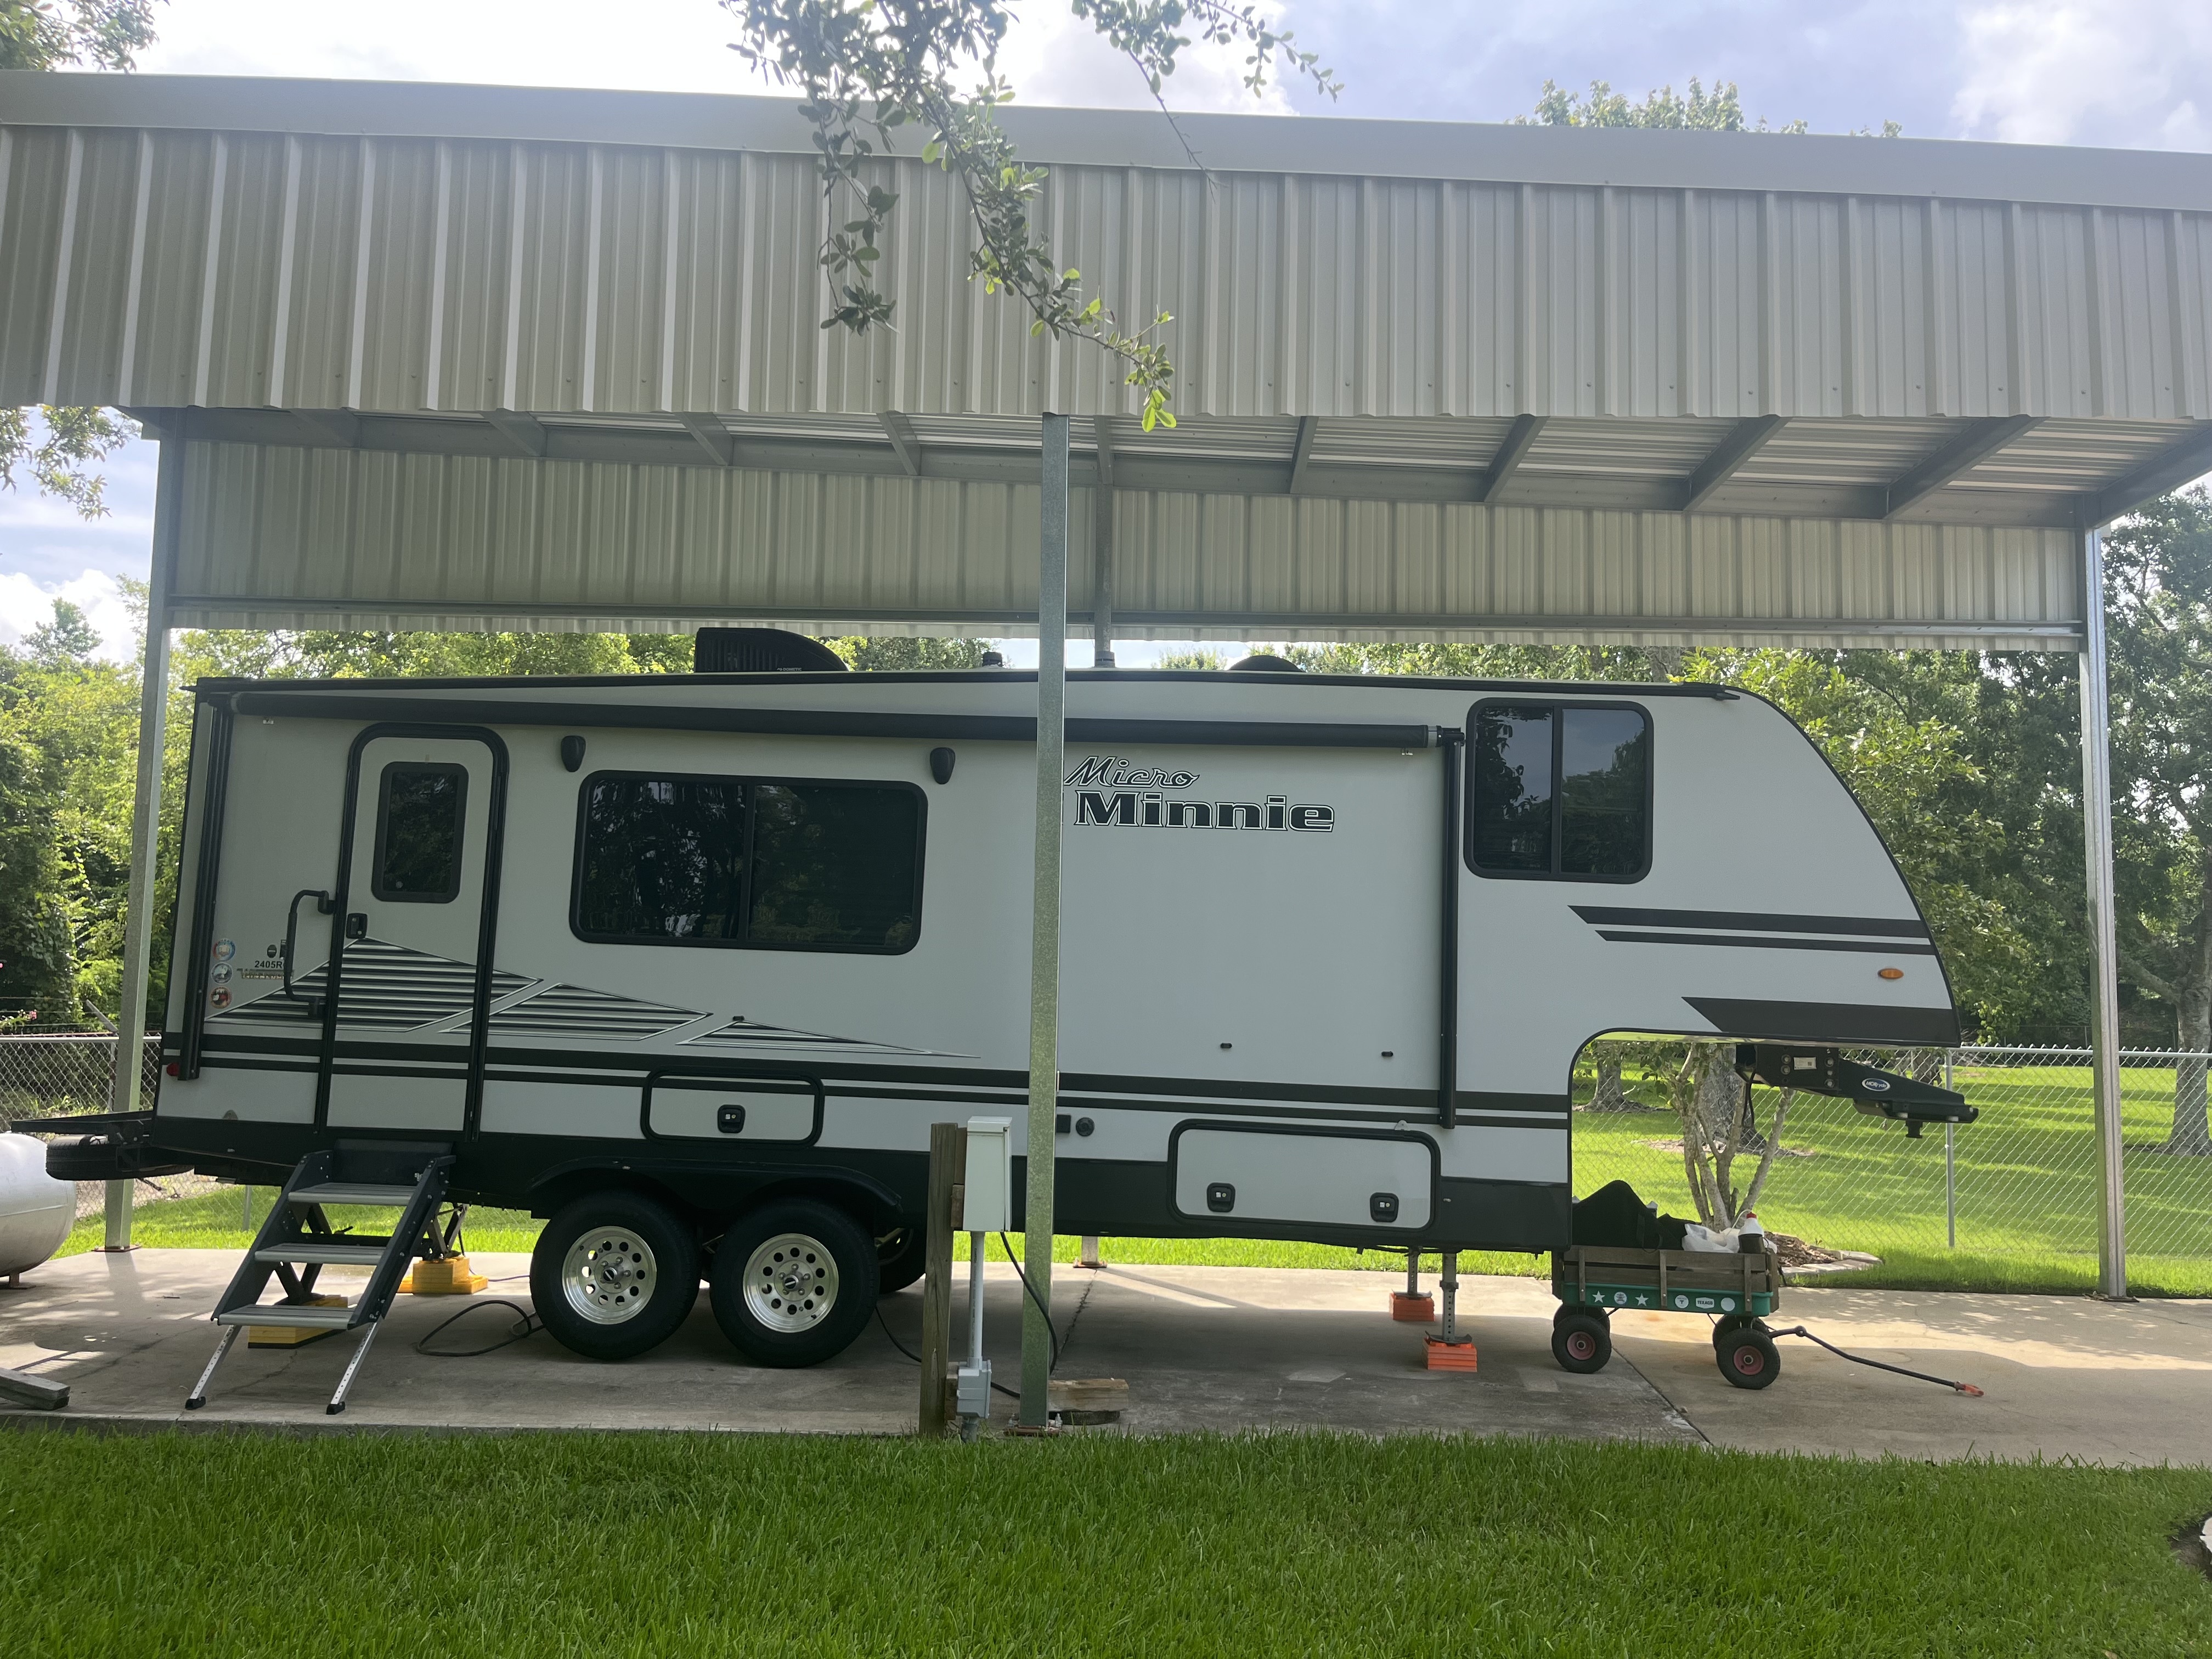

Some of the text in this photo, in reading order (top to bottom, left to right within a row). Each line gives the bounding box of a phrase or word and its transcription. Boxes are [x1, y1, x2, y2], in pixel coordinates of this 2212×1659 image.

[1063, 755, 1200, 788] Micro
[1074, 789, 1335, 832] Minnie
[255, 960, 284, 969] 2405R
